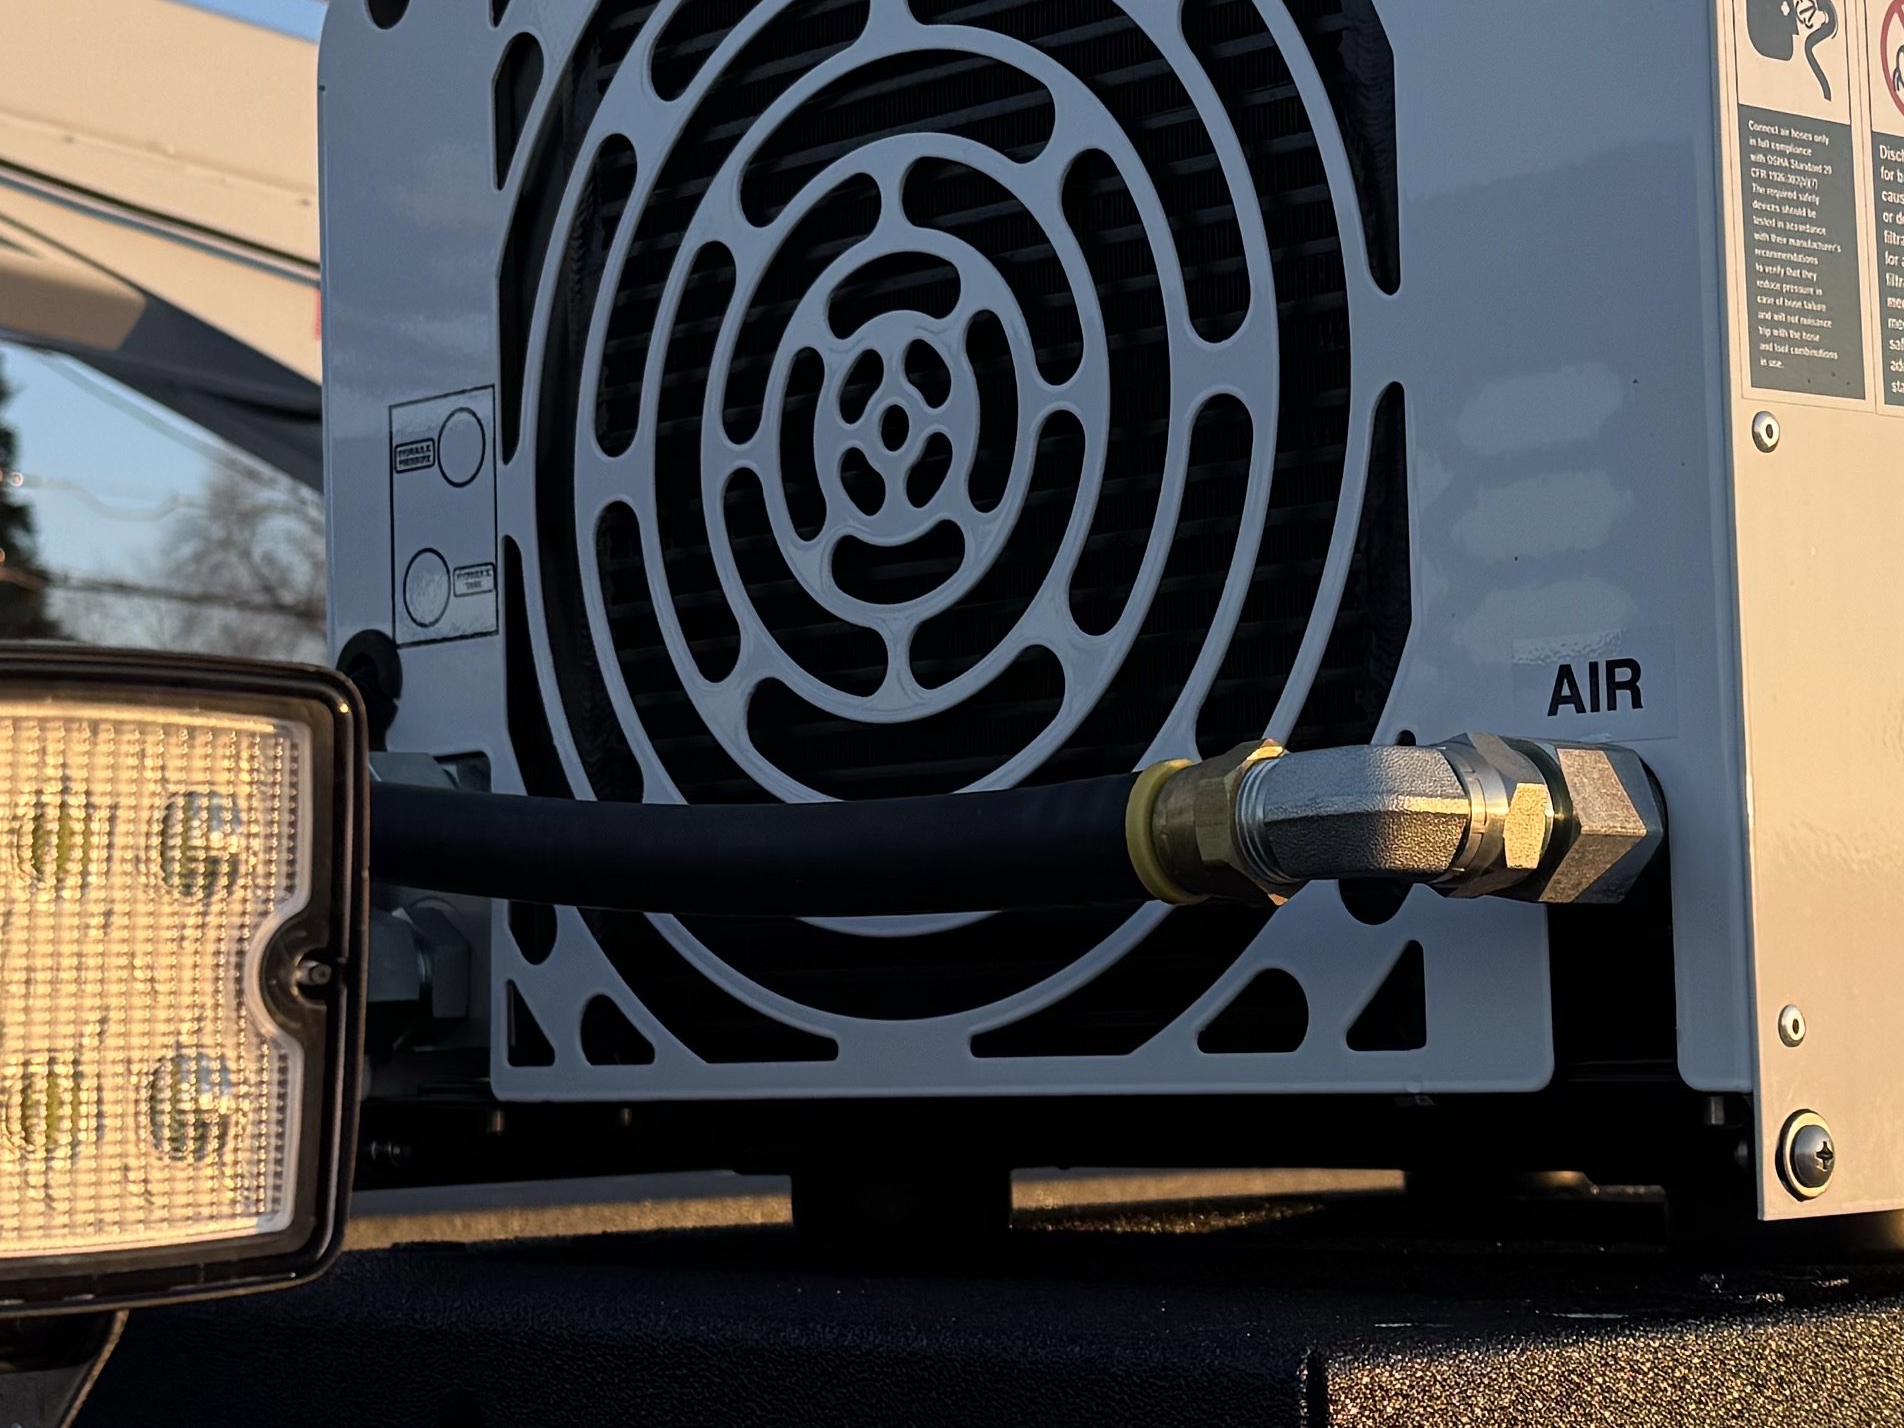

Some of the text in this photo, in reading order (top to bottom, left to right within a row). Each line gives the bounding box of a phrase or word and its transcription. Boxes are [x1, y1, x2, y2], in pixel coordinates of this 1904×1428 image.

[1749, 120, 1778, 133] Connect
[1814, 133, 1829, 145] only
[1772, 142, 1812, 156] compliance
[1881, 166, 1894, 180] for
[1883, 212, 1893, 223] or
[1885, 251, 1898, 265] for
[1548, 658, 1643, 716] AIR
